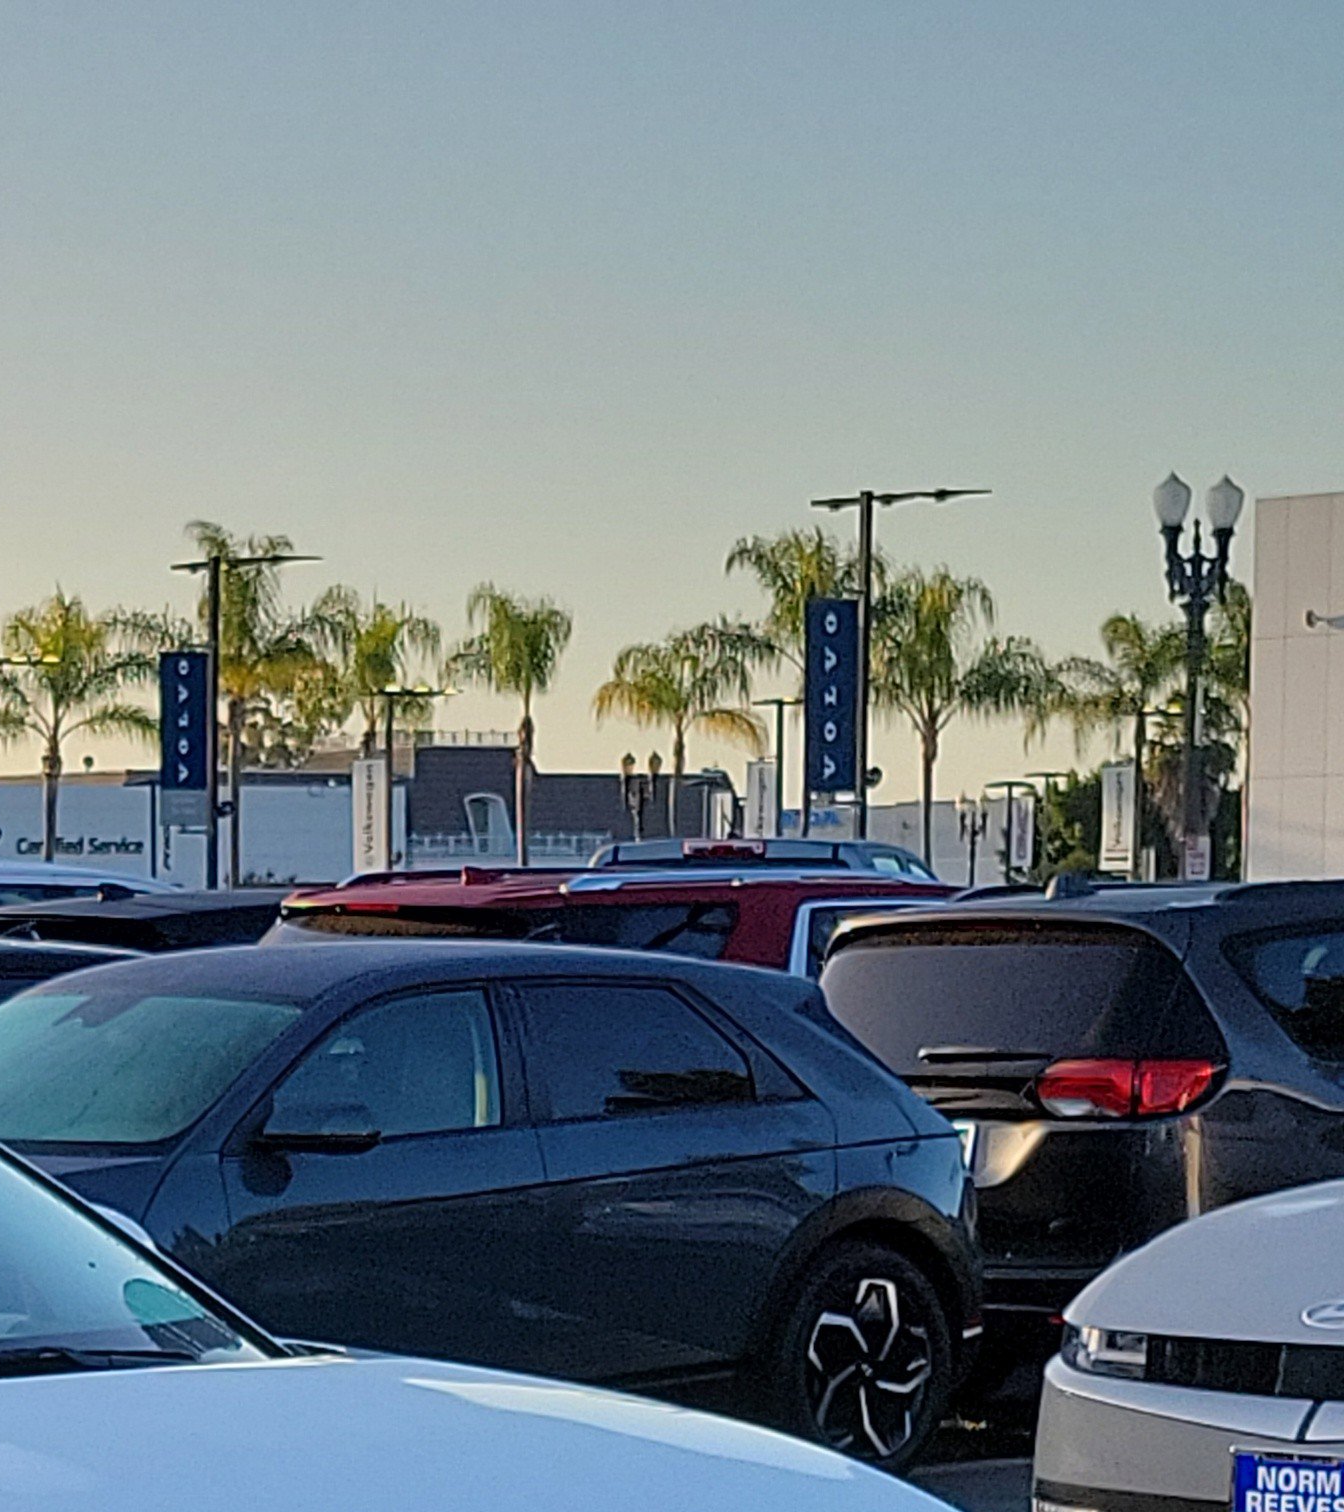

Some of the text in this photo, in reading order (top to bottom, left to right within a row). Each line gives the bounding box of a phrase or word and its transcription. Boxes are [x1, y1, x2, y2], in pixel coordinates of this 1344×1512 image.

[178, 659, 189, 782] VOLVO
[822, 610, 837, 779] VOLVO
[16, 836, 84, 855] Cerfied
[87, 836, 144, 855] Service
[1257, 1465, 1342, 1497] NORM
